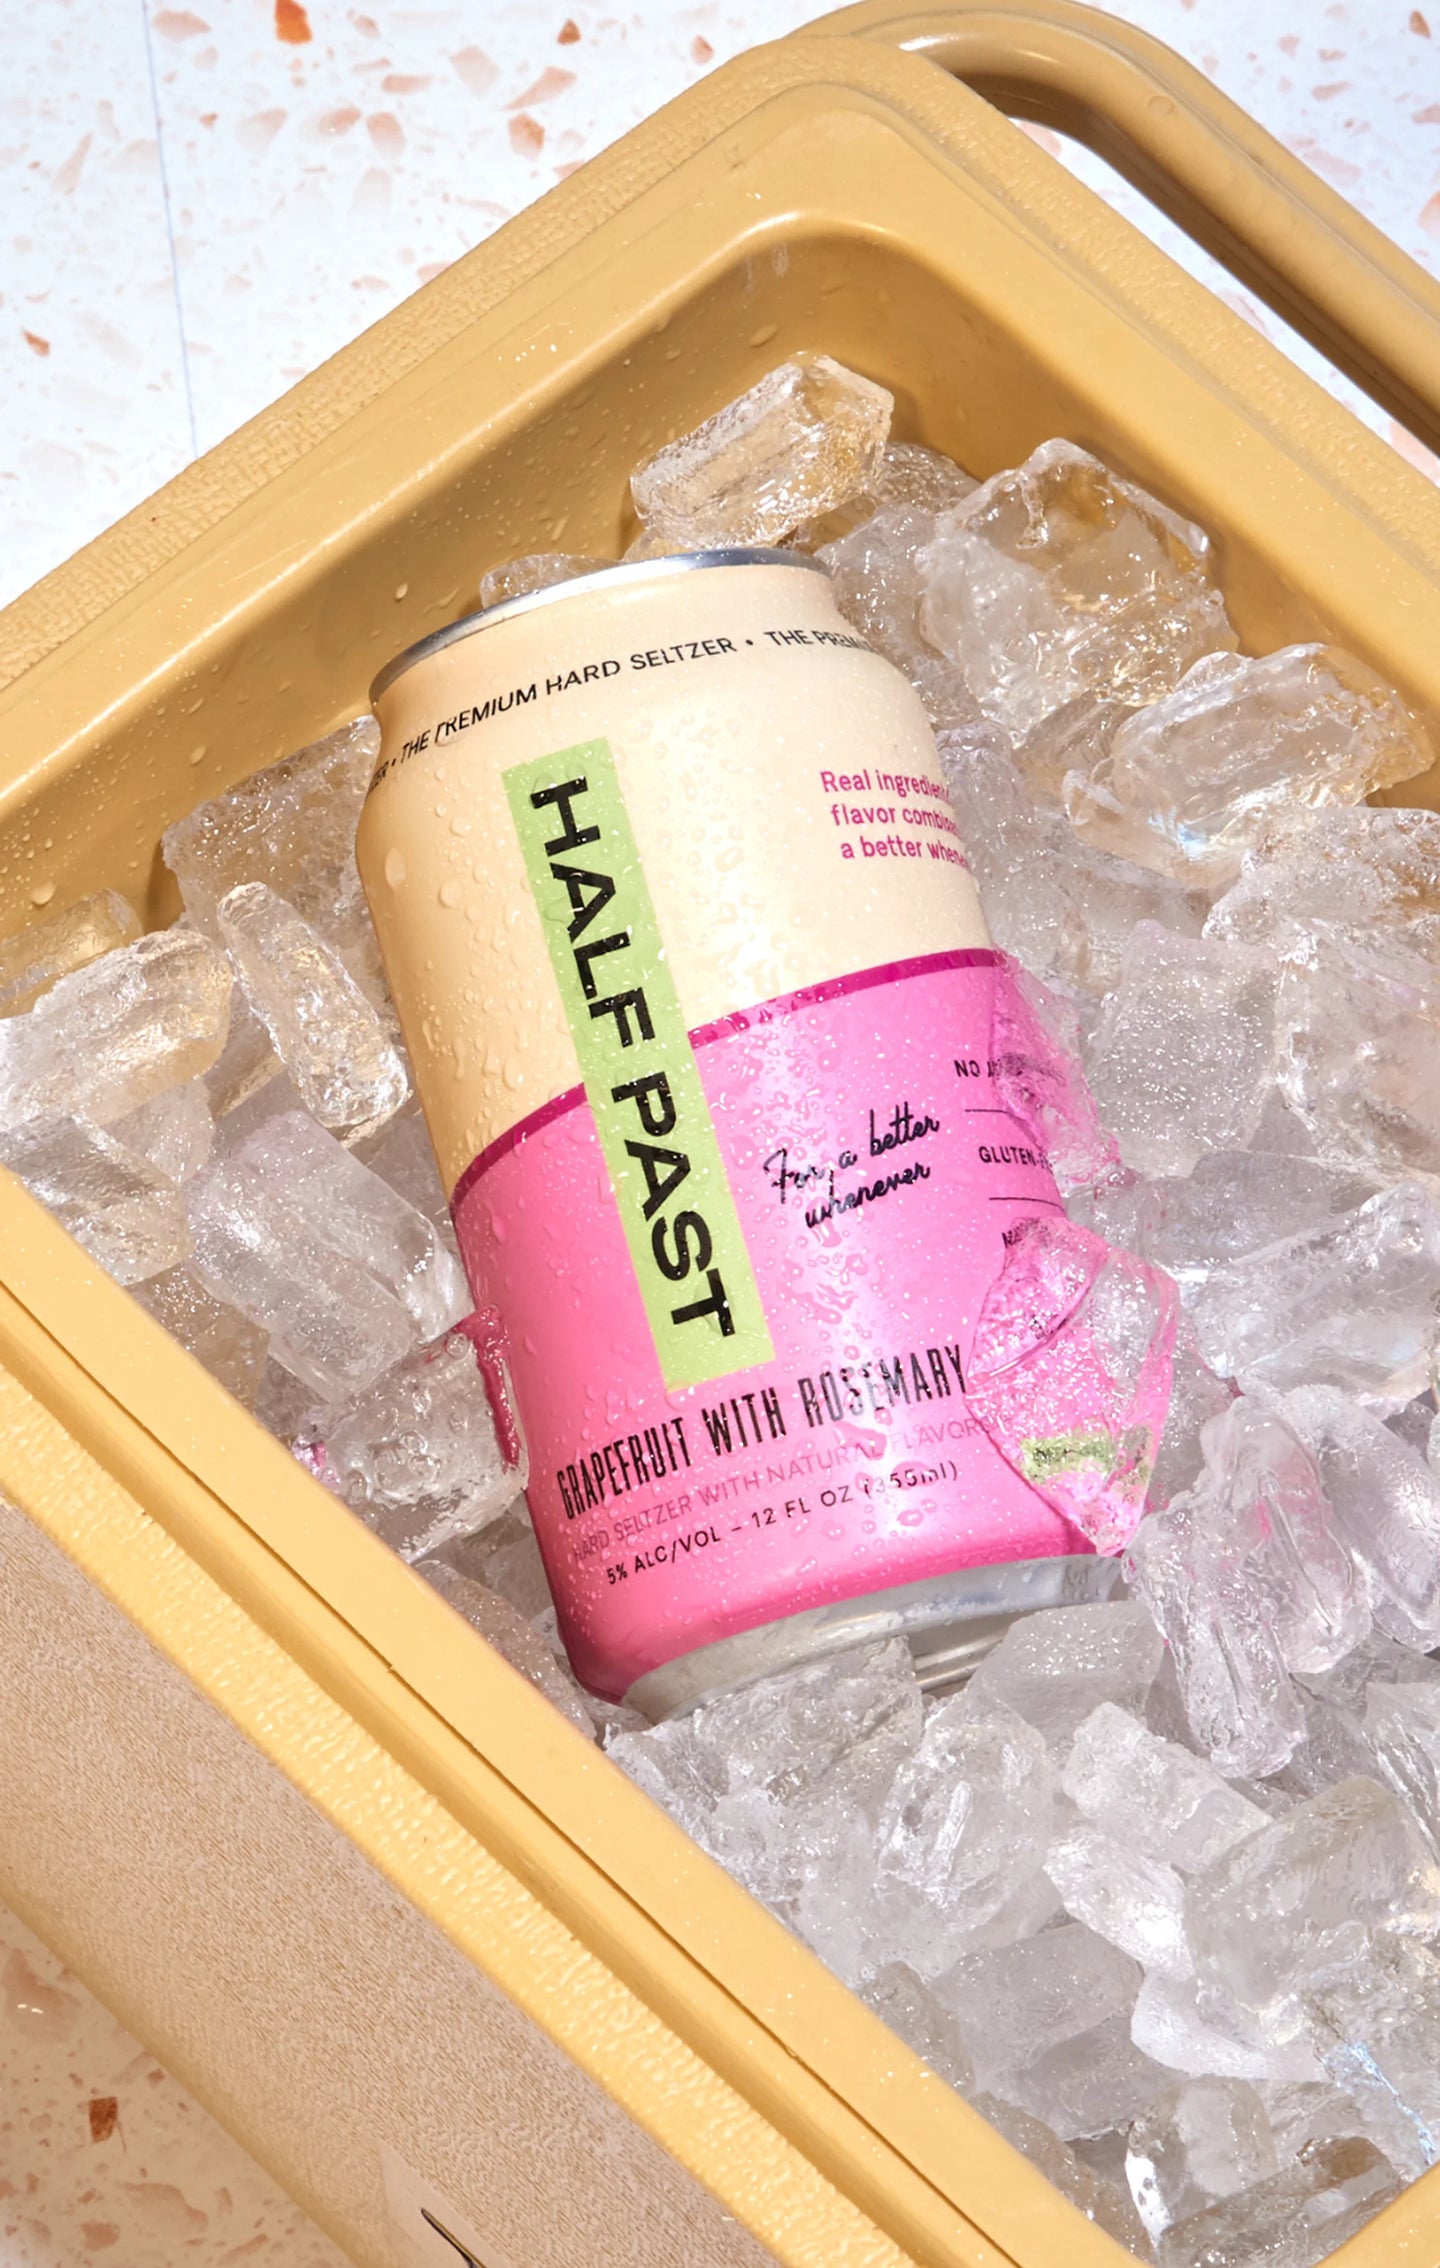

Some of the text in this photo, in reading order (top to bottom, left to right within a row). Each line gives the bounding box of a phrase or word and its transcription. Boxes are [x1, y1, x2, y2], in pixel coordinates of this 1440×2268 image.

[400, 729, 431, 763] THE
[434, 684, 537, 744] PREMIUM
[545, 660, 621, 695] HARD
[630, 637, 737, 670] SELTZER
[764, 629, 813, 647] THE
[820, 769, 872, 793] Real
[831, 803, 896, 826] flavor
[840, 841, 855, 860] a
[860, 835, 922, 859] better
[530, 776, 736, 1337] HALF PAST
[954, 1060, 980, 1078] NO
[762, 1101, 940, 1204] For a better
[804, 1161, 931, 1228] whenever
[556, 1344, 967, 1520] GRAPEFRUIT WITH ROSEMARY
[572, 1530, 609, 1562] HARD
[613, 1495, 693, 1541] SELTZER
[698, 1471, 760, 1507] WITH
[766, 1440, 884, 1483] NATURAL
[607, 1562, 628, 1585] 5%
[635, 1526, 721, 1574] ALC/VOL
[752, 1507, 776, 1528] 12
[785, 1496, 811, 1518] FL
[820, 1485, 853, 1507] OZ
[864, 1461, 958, 1499] (355ml)
